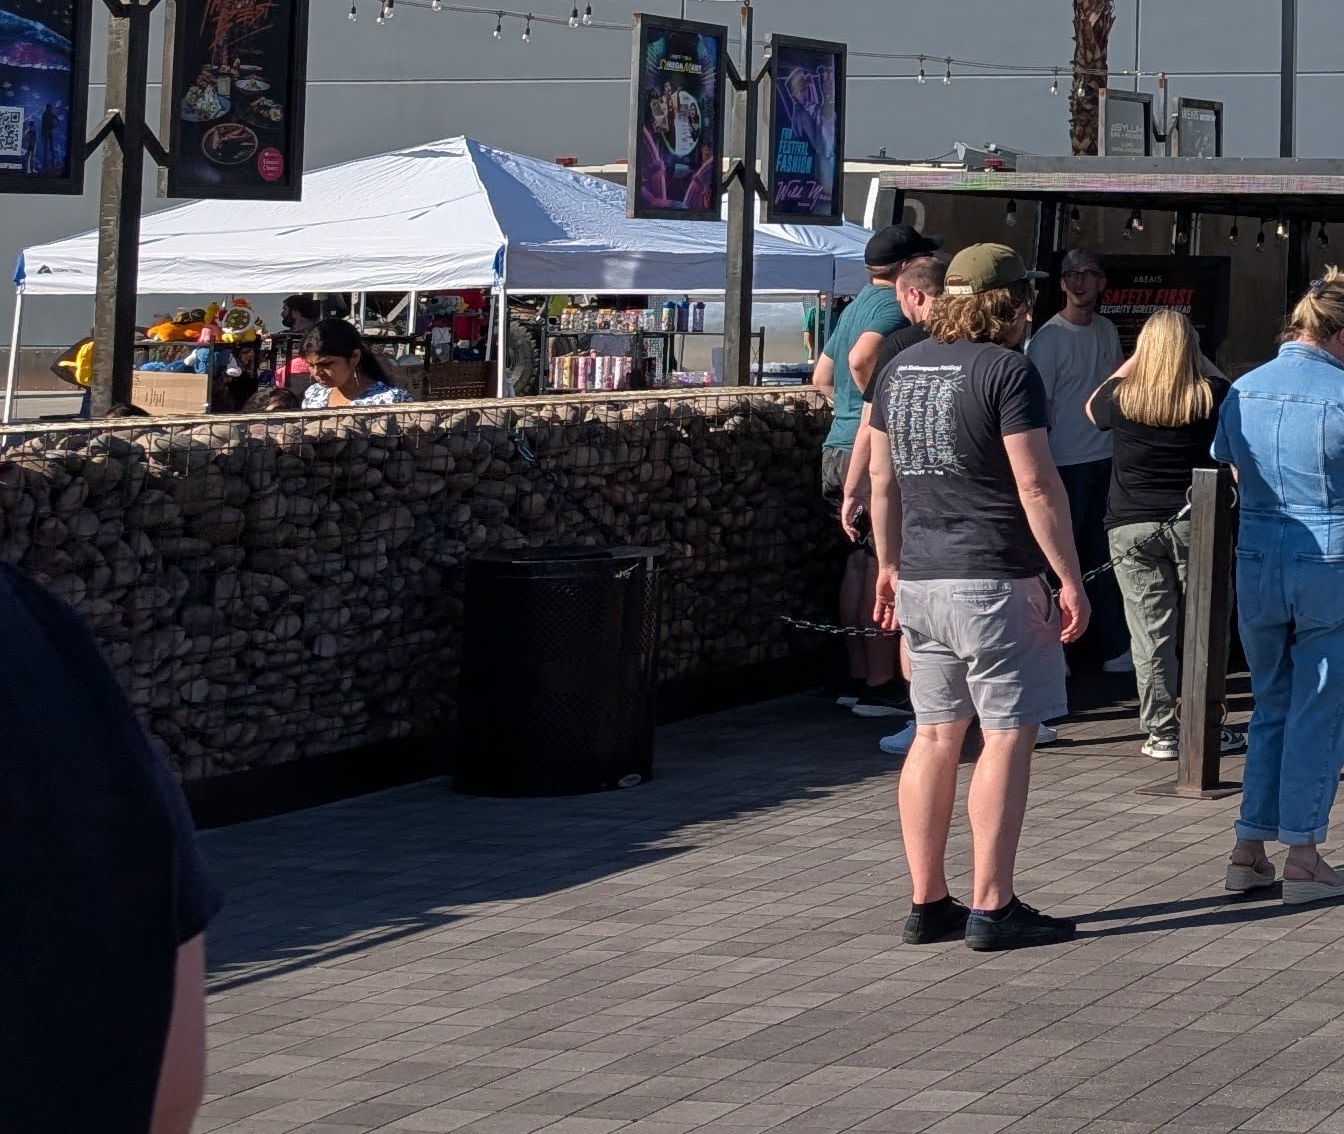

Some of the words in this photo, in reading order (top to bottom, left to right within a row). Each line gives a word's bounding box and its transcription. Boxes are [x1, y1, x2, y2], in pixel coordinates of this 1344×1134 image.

[778, 140, 808, 155] FESTIVAL
[776, 154, 812, 173] FASHION
[1133, 275, 1162, 283] AREA15
[1102, 289, 1152, 304] SAFETY
[1155, 289, 1195, 304] FIRST
[1100, 305, 1131, 314] SECURITY
